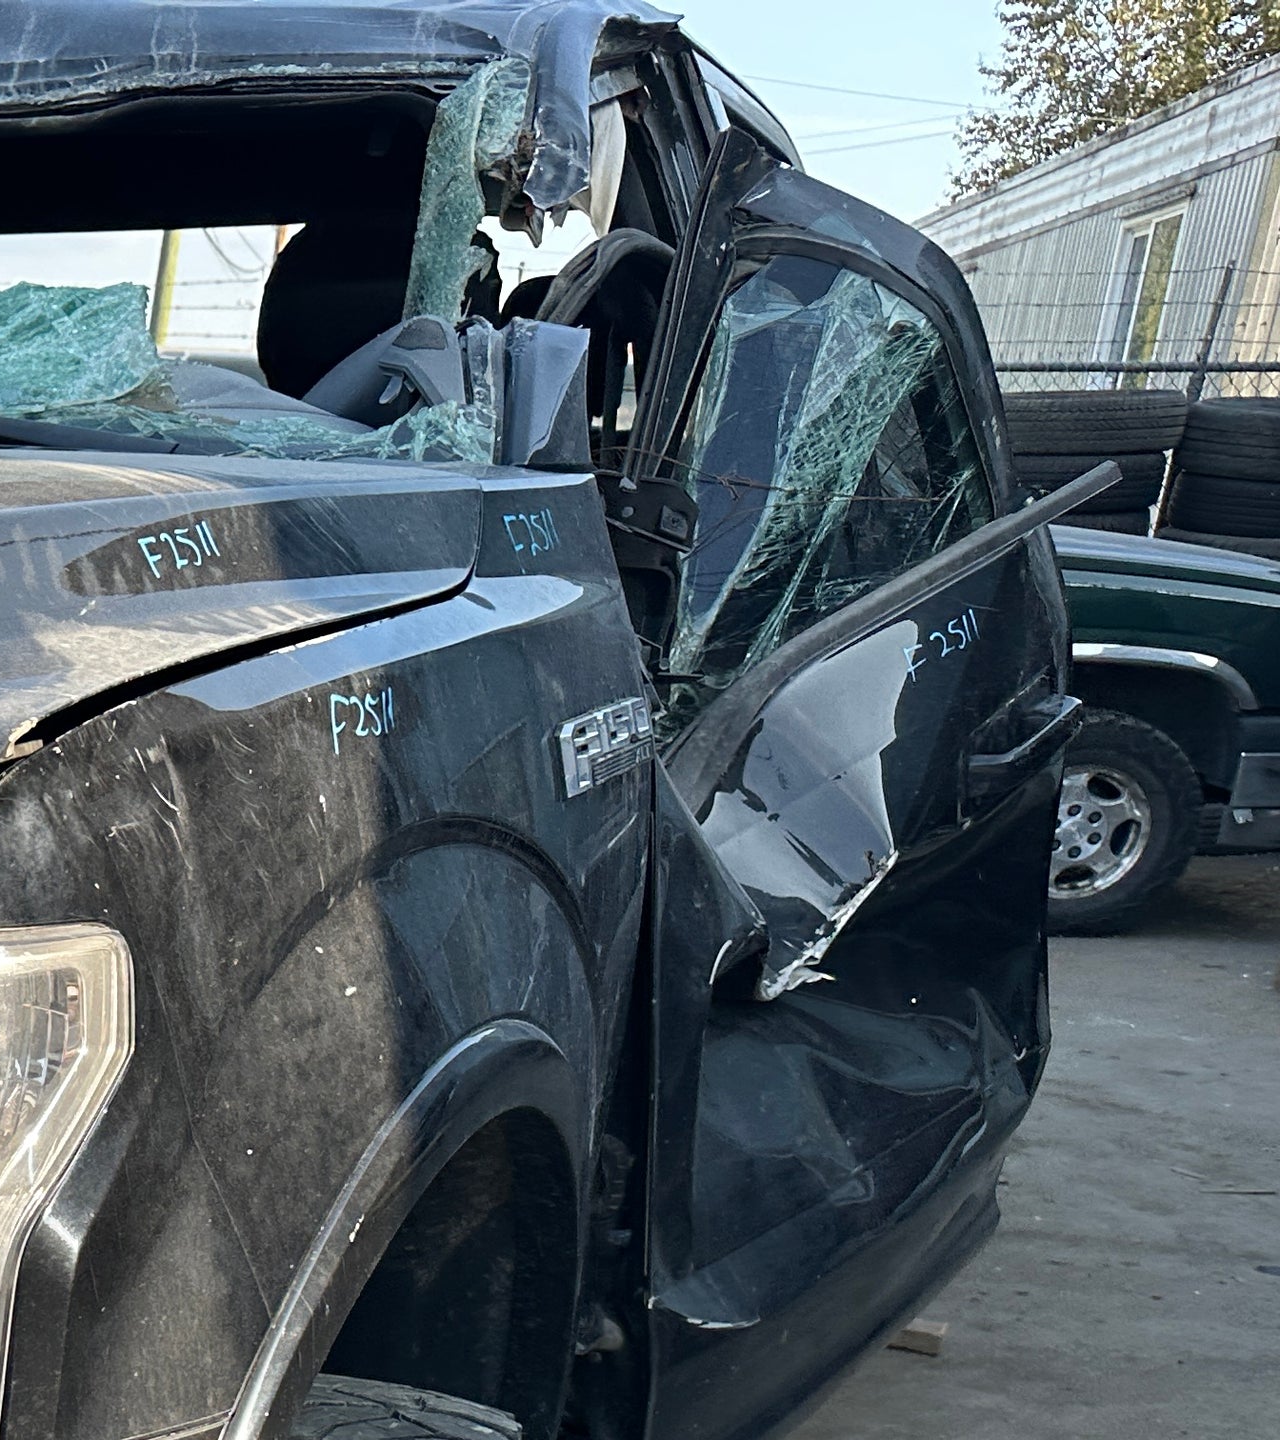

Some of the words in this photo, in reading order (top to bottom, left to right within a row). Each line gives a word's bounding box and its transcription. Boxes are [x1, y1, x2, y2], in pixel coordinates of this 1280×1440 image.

[137, 520, 221, 579] F2511
[502, 508, 560, 575] F2511
[330, 686, 395, 755] F2511
